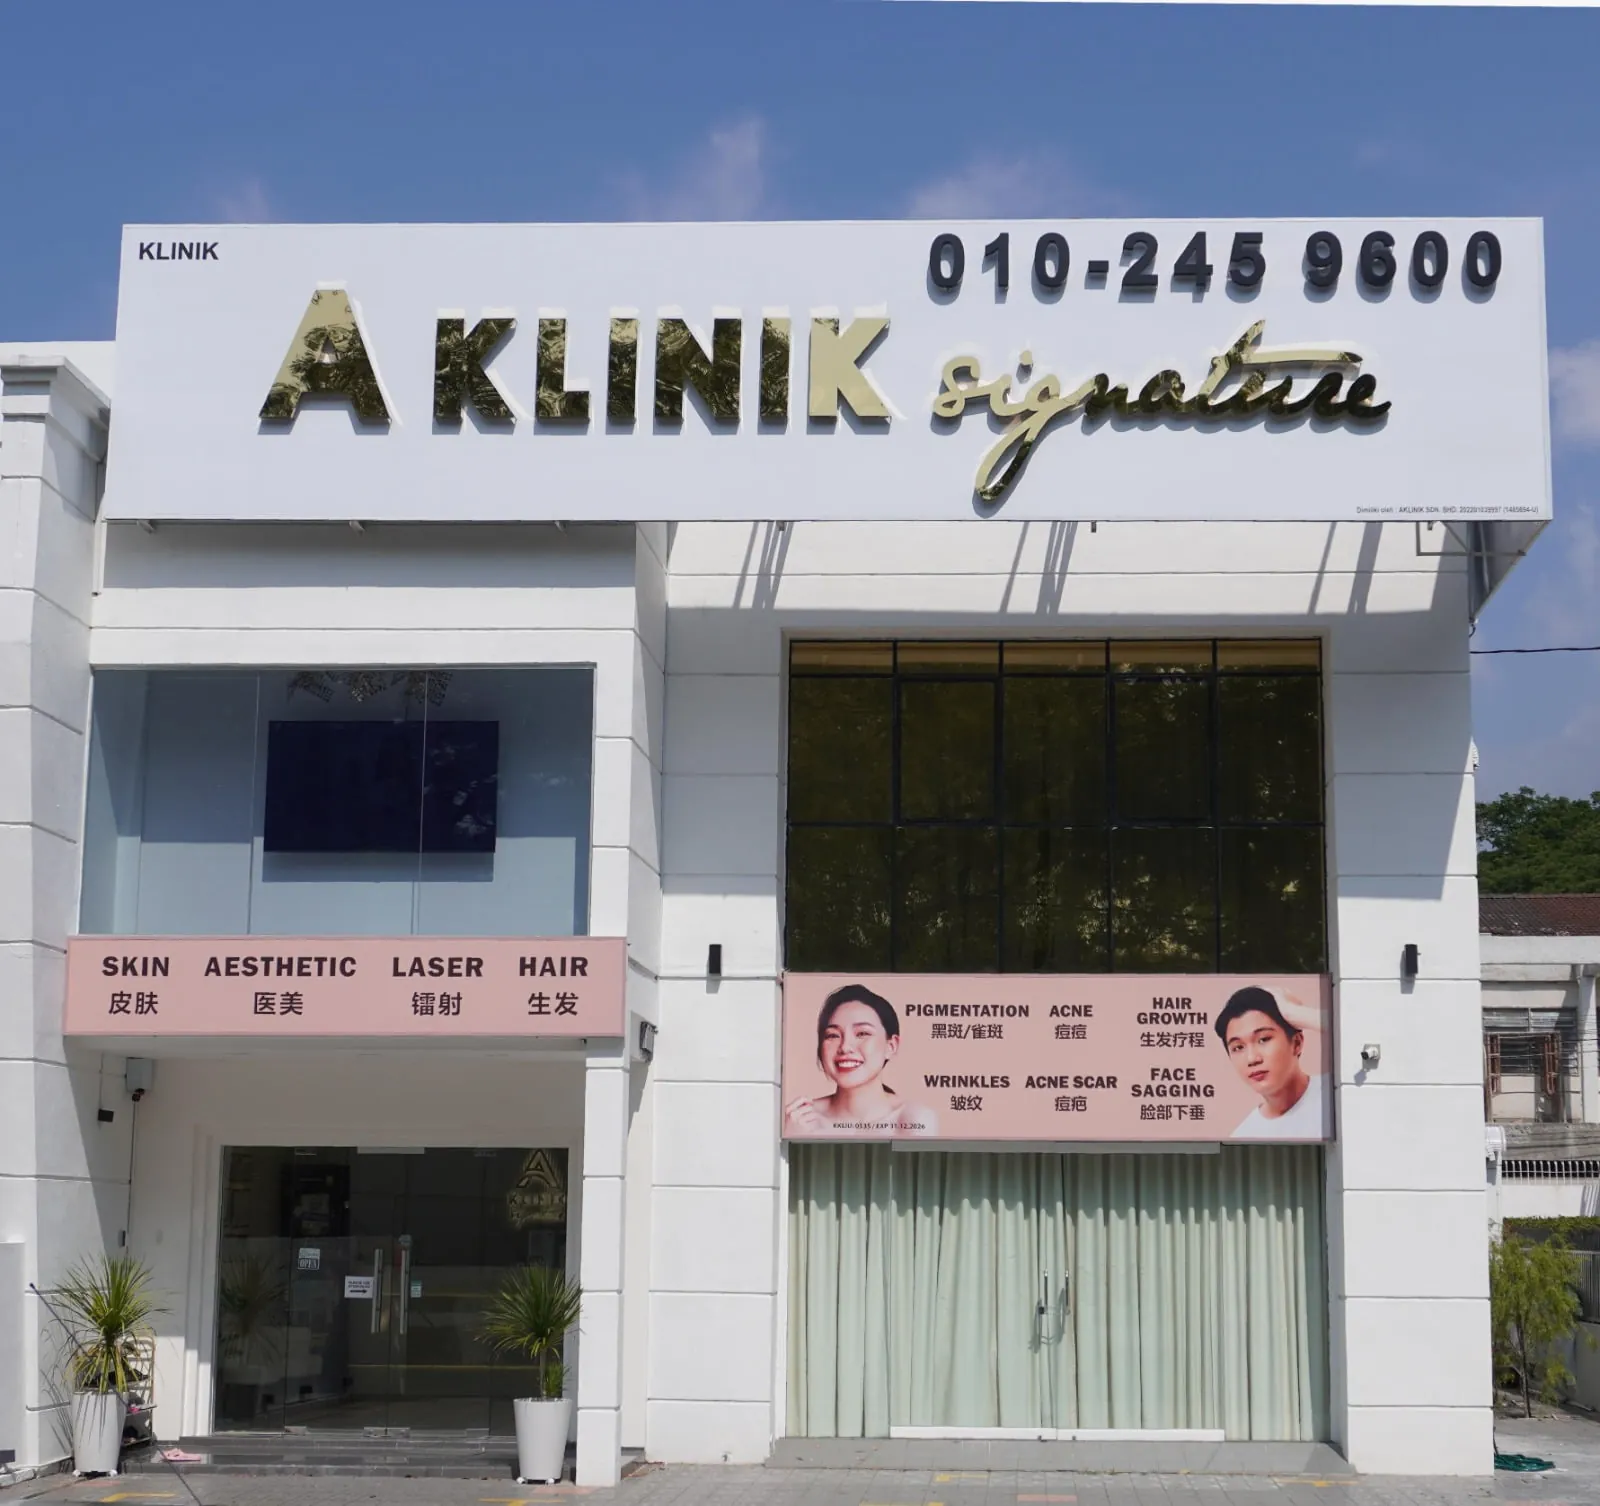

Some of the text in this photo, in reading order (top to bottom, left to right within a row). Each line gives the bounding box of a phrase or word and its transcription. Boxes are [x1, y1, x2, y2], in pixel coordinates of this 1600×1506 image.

[138, 241, 219, 261] KLINIK
[929, 230, 1501, 289] 010-245 9600
[259, 288, 1391, 500] A KLINIK signature
[1398, 506, 1425, 514] AKLINIK
[102, 956, 169, 977] SKIN
[204, 956, 356, 978] AESTHETIC
[392, 956, 483, 978] LASER
[519, 956, 588, 977] HAIR
[108, 990, 159, 1016] 皮肤
[253, 991, 304, 1016] 医美
[411, 991, 463, 1017] 镭射
[527, 991, 579, 1016] 生发
[905, 1003, 1030, 1018] PIGMENTATION
[1049, 1004, 1093, 1018] ACNE
[1152, 996, 1192, 1010] HAIR
[1136, 1012, 1208, 1026] GROWTH
[931, 1023, 1004, 1040] 黑斑/雀斑
[1054, 1023, 1088, 1040] 痘痘
[1139, 1031, 1205, 1048] 生发疗程
[923, 1074, 1011, 1089] WRINKLES
[1024, 1075, 1118, 1089] ACNE SCAR
[1150, 1067, 1196, 1082] FACE
[1131, 1083, 1215, 1098] SAGGING
[950, 1094, 983, 1112] 皱纹
[1054, 1095, 1088, 1112] 痘疤
[1139, 1103, 1206, 1121] 脸部下垂
